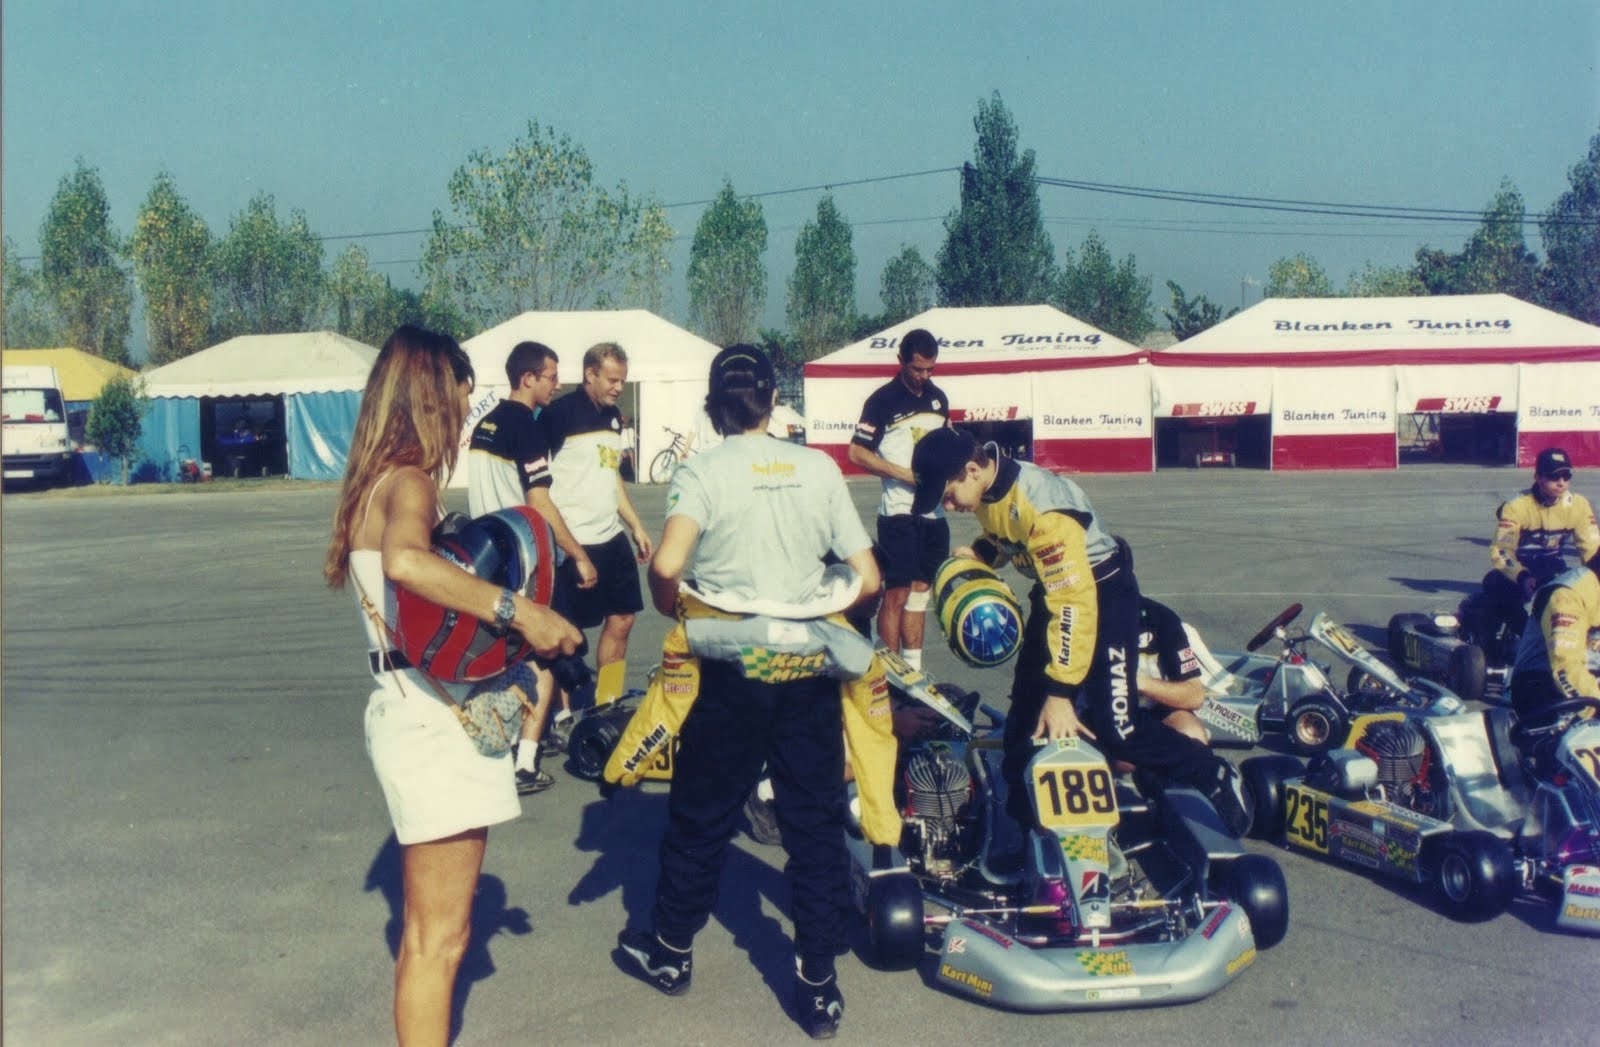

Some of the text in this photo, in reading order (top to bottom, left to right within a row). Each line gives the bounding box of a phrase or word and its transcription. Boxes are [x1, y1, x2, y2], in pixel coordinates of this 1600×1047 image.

[1273, 318, 1512, 331] Blanken Tuning
[869, 332, 1101, 349] Blken Tuning
[963, 407, 1009, 421] SWISS
[1199, 401, 1248, 416] SWISS
[1441, 397, 1492, 414] SWISS
[1528, 405, 1582, 417] Blanken
[1043, 414, 1143, 426] Blanken Tuning
[1282, 409, 1387, 421] Blanken Tuning
[1058, 606, 1072, 666] Kart Mini
[768, 652, 825, 668] Kart
[1108, 647, 1134, 741] THOMAZ
[624, 724, 667, 771] Kart Mini
[1039, 769, 1115, 815] 189
[1287, 787, 1328, 848] 235
[942, 964, 968, 982] Kart
[967, 974, 993, 993] Mini
